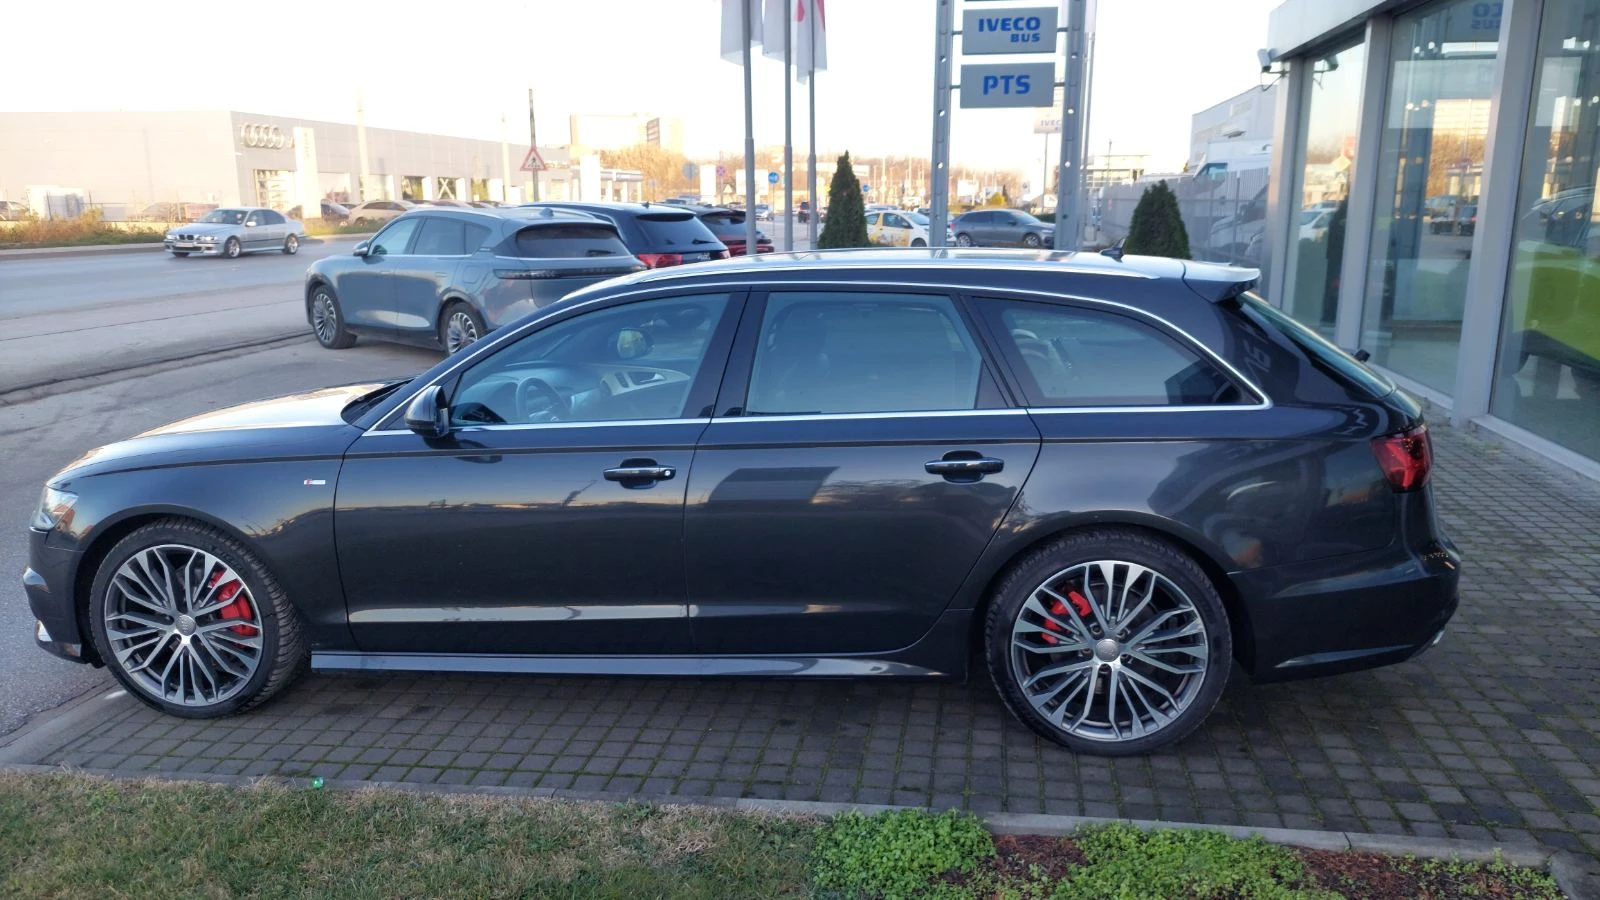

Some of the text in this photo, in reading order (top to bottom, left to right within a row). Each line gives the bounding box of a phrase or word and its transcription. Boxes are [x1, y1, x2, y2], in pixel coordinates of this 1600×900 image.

[978, 16, 1041, 32] IVECO
[1010, 33, 1041, 43] BUS
[982, 74, 1031, 95] PTS
[1040, 119, 1062, 127] IVEC
